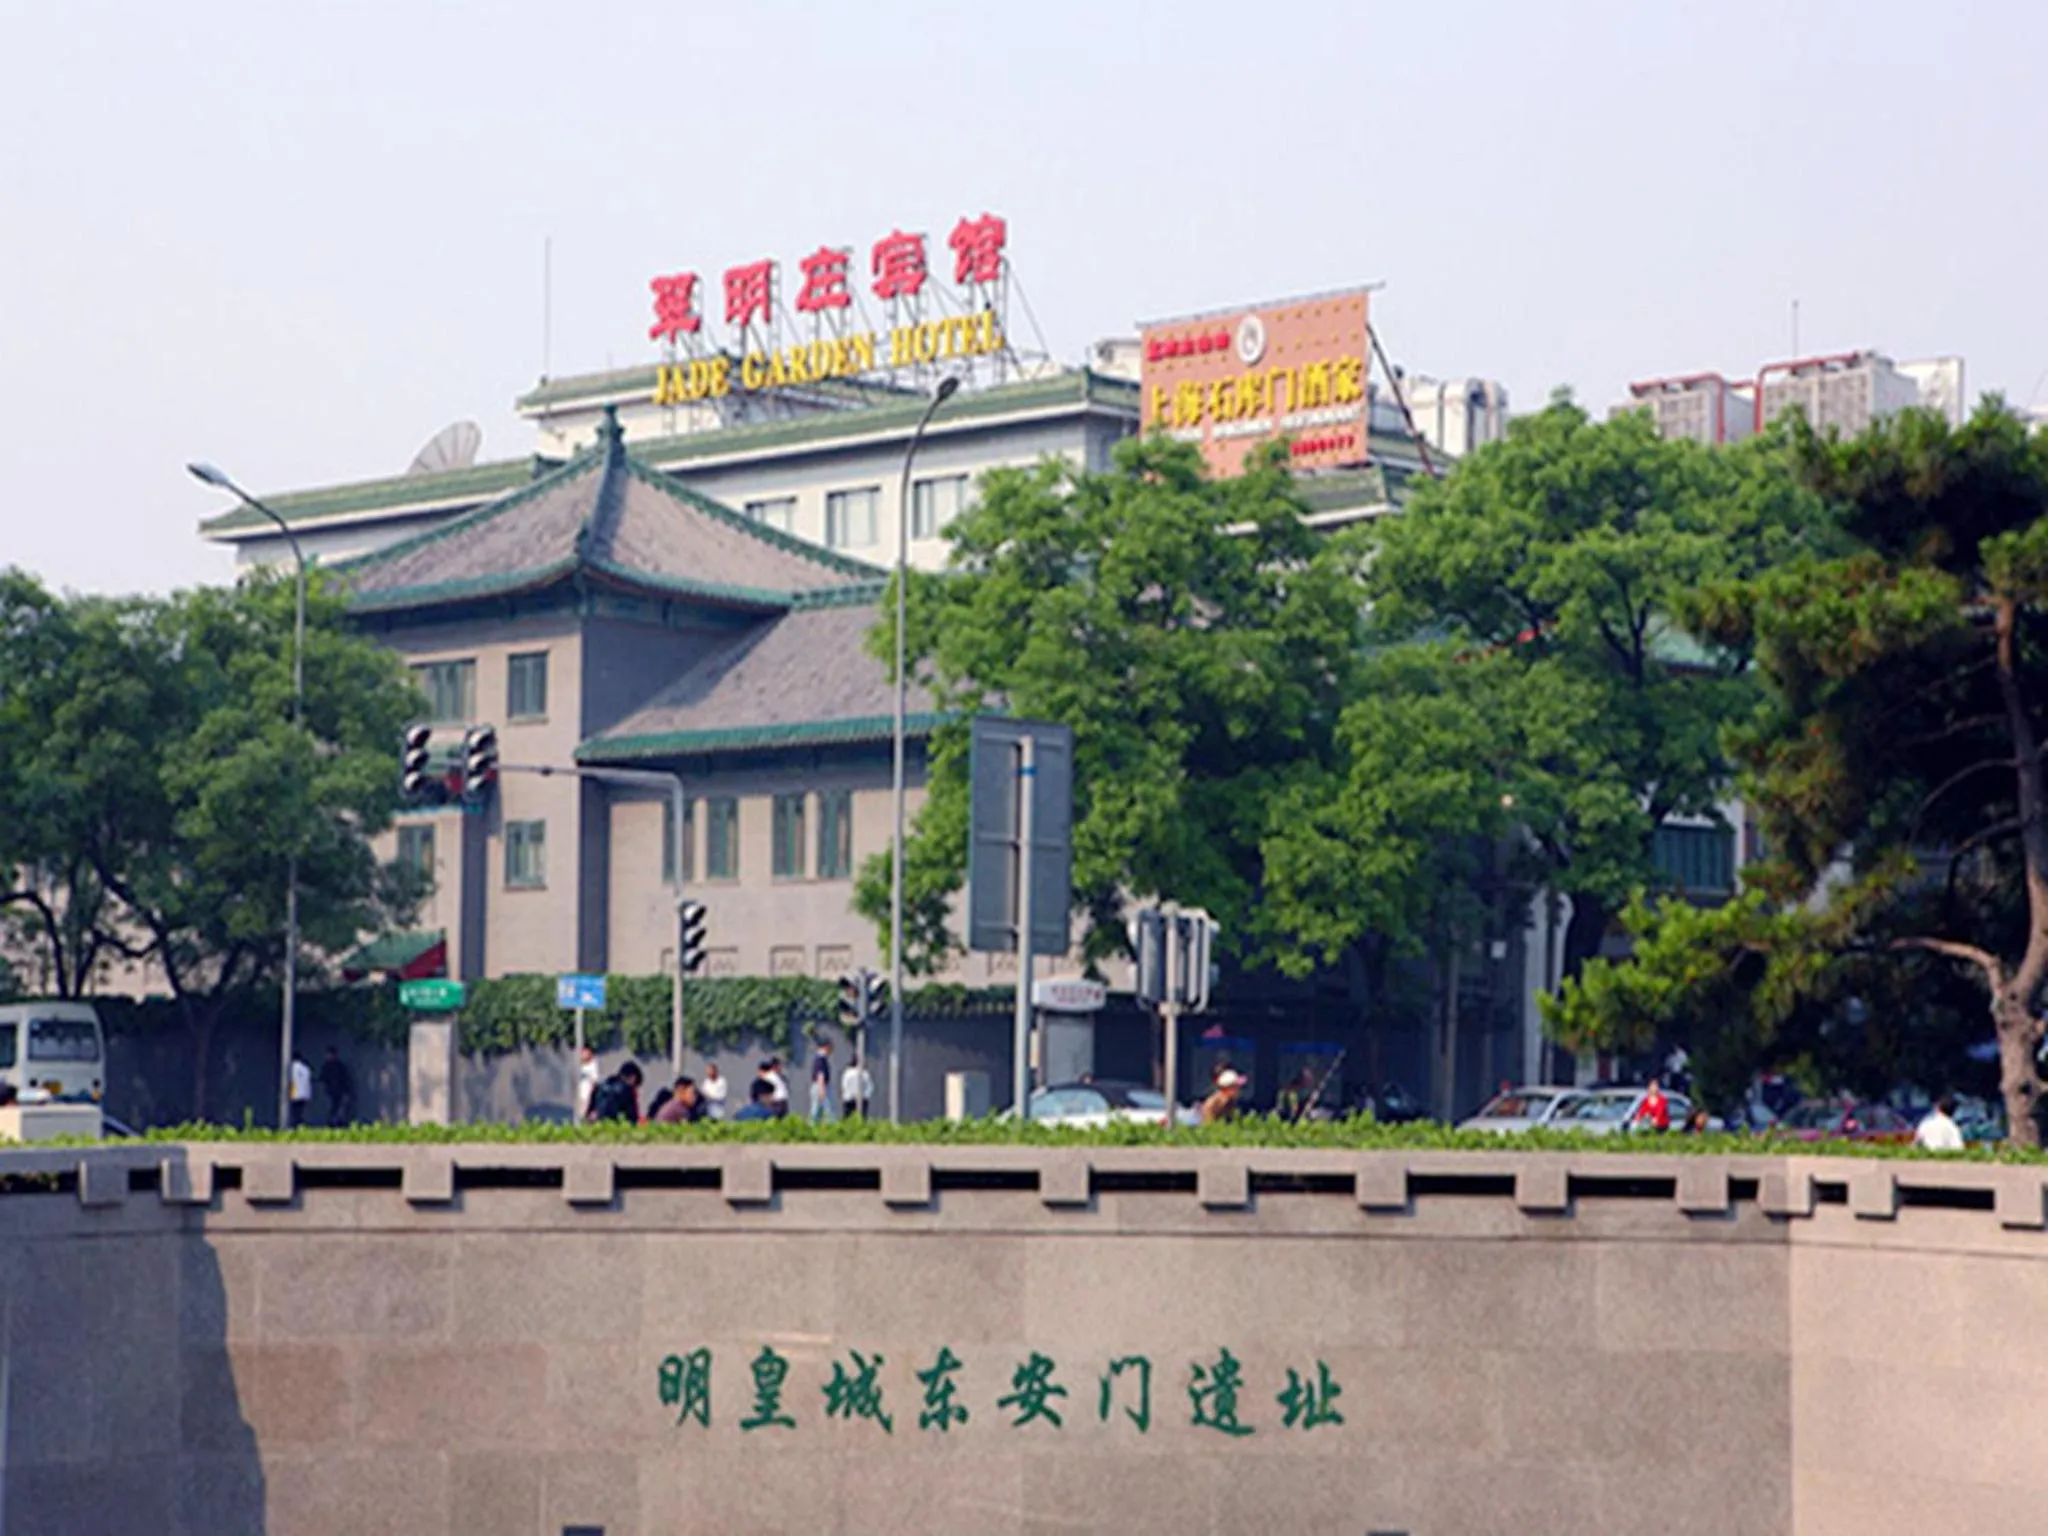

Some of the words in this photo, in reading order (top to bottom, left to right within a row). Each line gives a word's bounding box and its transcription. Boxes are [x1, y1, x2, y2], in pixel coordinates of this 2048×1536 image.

[649, 213, 1006, 343] 翠明庄宾馆
[653, 357, 731, 405] JADE
[742, 332, 875, 390] GARDEN
[889, 309, 1004, 367] HOTEL
[658, 1346, 1343, 1437] 明皇城东安门遗址
